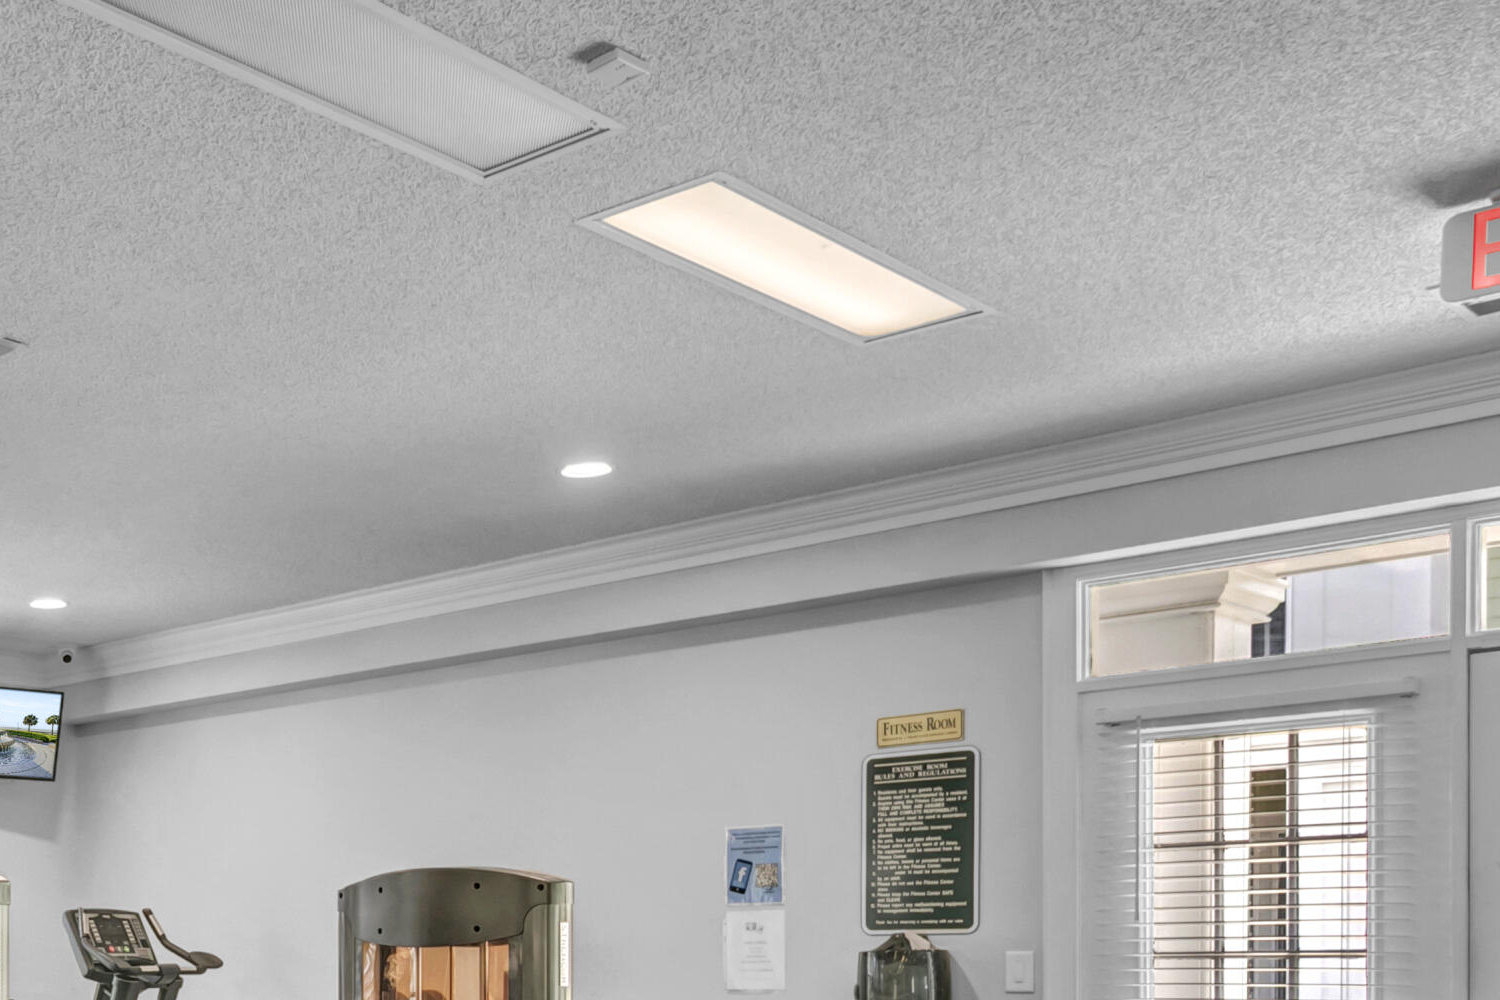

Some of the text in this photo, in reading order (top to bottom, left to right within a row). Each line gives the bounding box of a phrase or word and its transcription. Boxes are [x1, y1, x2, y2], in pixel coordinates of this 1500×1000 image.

[883, 717, 956, 736] FITNESS ROOM
[898, 771, 915, 779] AND
